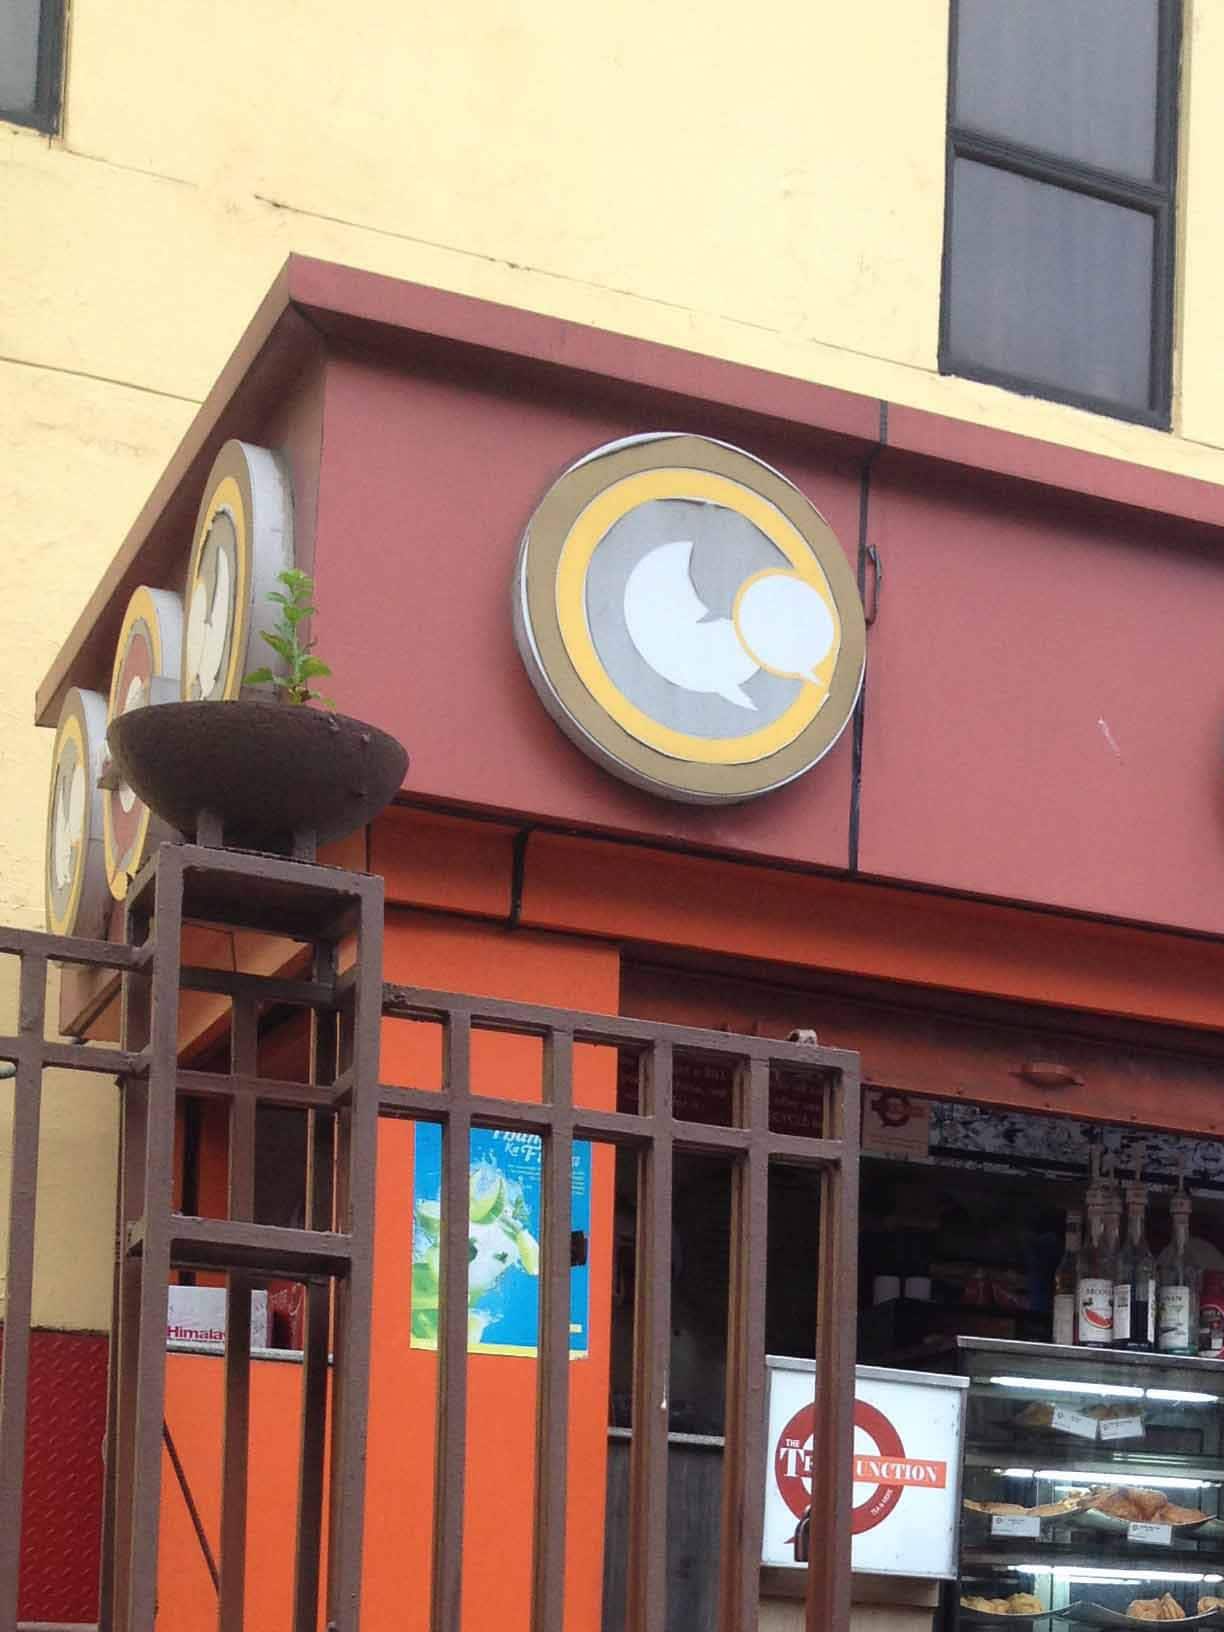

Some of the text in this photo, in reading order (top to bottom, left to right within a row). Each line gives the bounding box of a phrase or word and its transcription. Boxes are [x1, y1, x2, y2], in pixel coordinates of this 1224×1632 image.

[168, 1326, 225, 1340] Himala
[785, 1438, 800, 1448] THE
[855, 1460, 937, 1483] UNCTION
